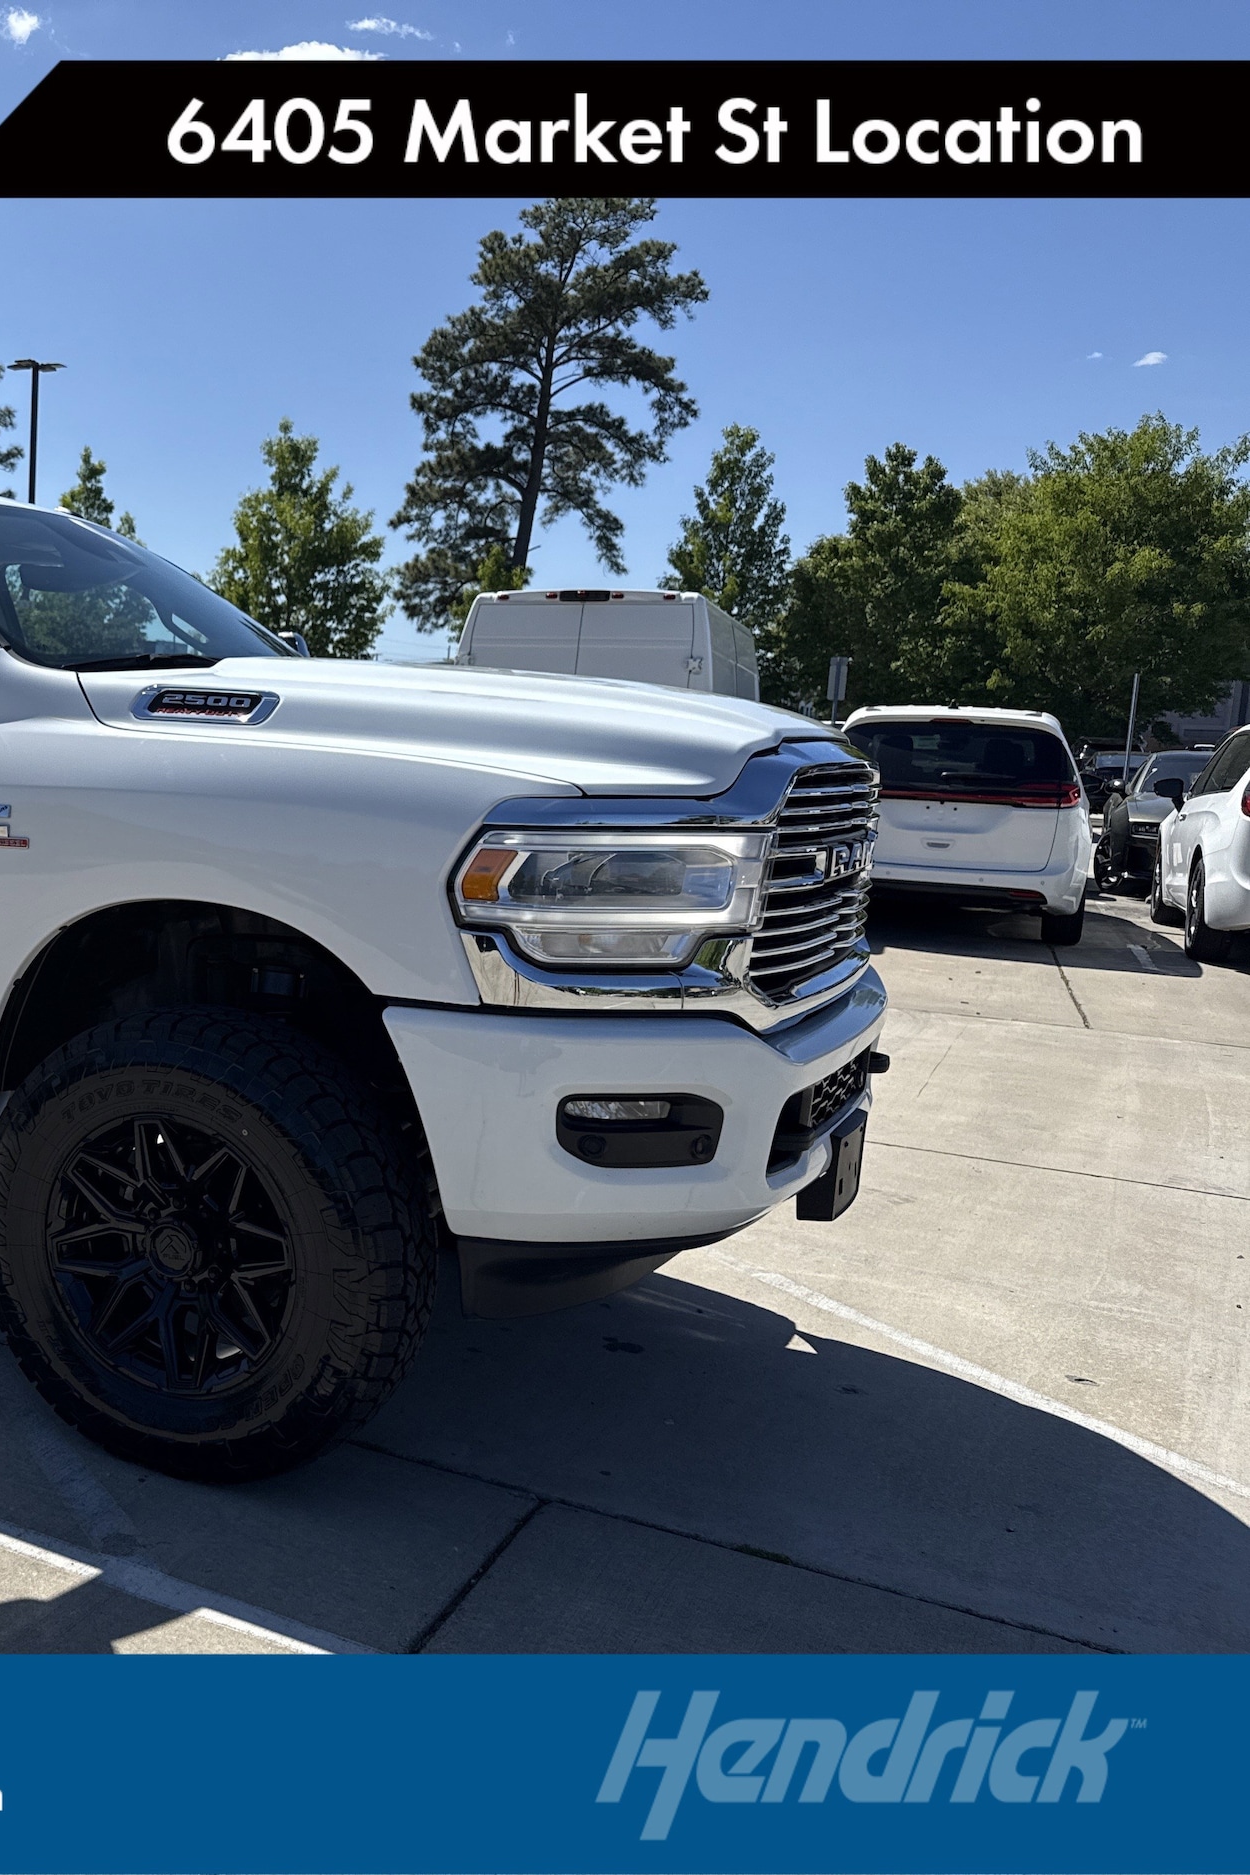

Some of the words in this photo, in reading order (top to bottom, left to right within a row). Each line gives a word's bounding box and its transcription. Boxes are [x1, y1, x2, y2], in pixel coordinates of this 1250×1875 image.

[162, 693, 252, 708] 2500
[830, 840, 875, 878] RAM
[60, 1079, 136, 1124] TOYO
[141, 1079, 244, 1124] TIRES
